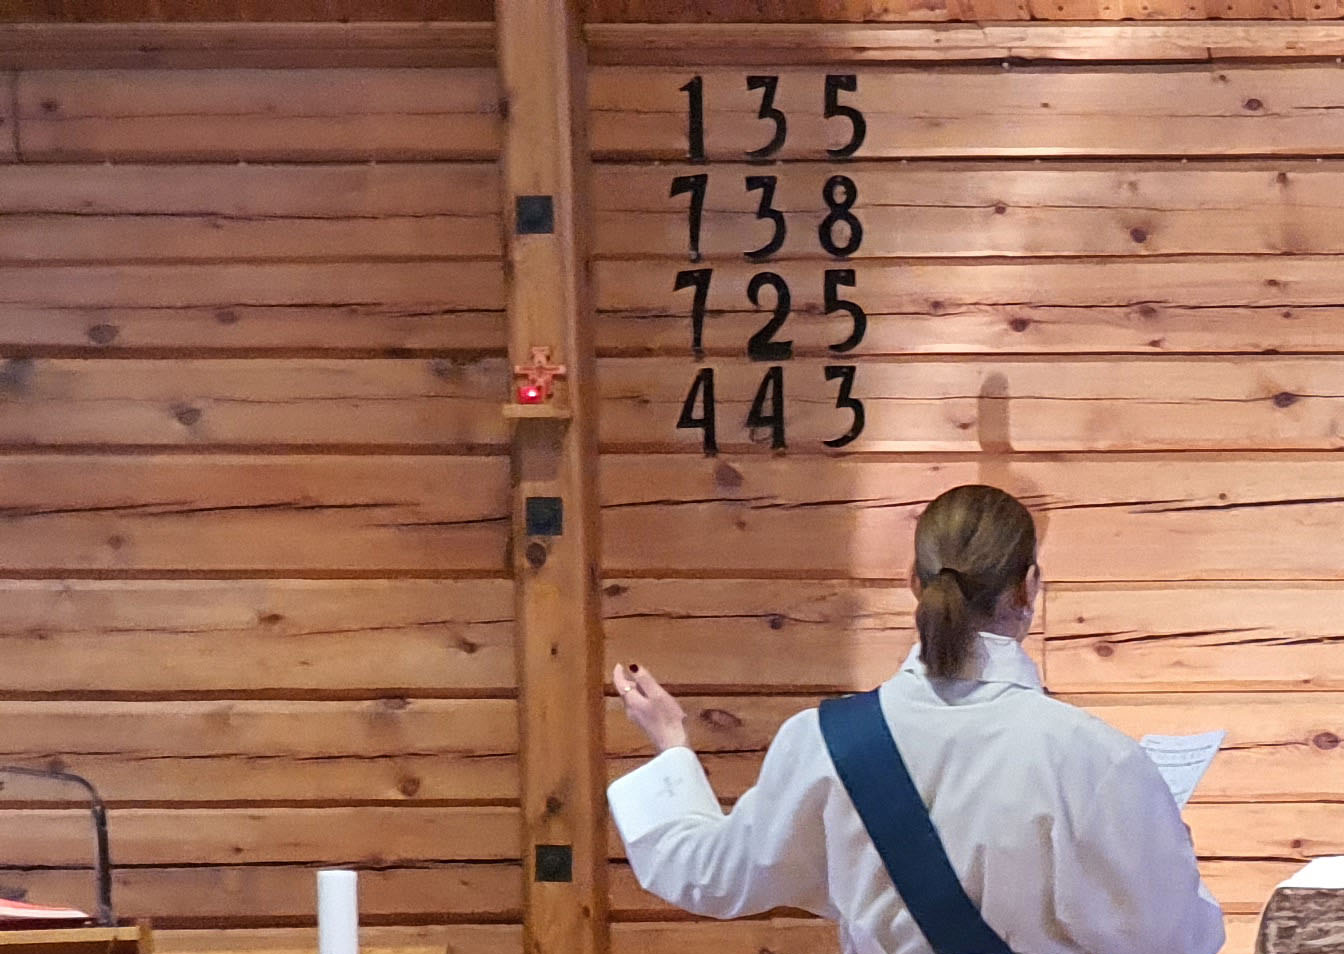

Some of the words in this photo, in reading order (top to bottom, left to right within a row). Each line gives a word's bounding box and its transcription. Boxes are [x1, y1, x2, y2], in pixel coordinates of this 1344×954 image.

[680, 74, 866, 160] 135
[669, 174, 863, 262] 738
[673, 268, 867, 360] 725
[676, 365, 865, 455] 443
